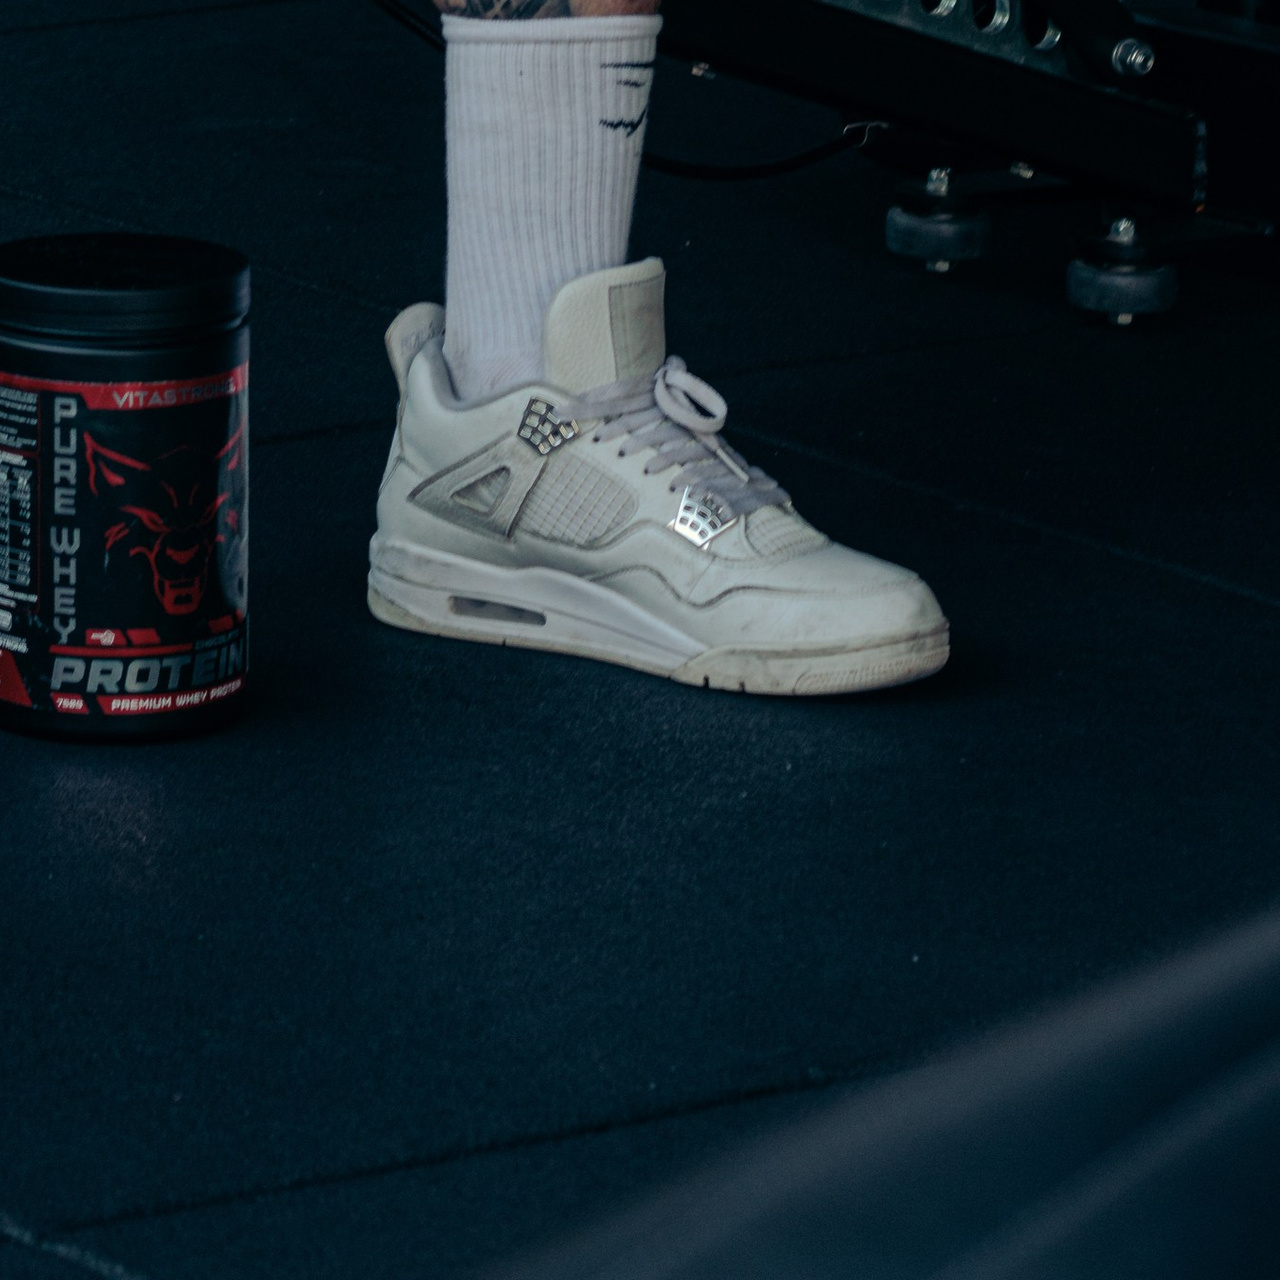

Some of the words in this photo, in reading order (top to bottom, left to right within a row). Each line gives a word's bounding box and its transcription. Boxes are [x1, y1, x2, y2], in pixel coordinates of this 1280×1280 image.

[52, 396, 79, 516] PURE
[50, 526, 81, 644] WHEY
[50, 638, 245, 694] PROTEIN
[111, 696, 173, 712] PREMIUM
[176, 689, 208, 707] WHEY
